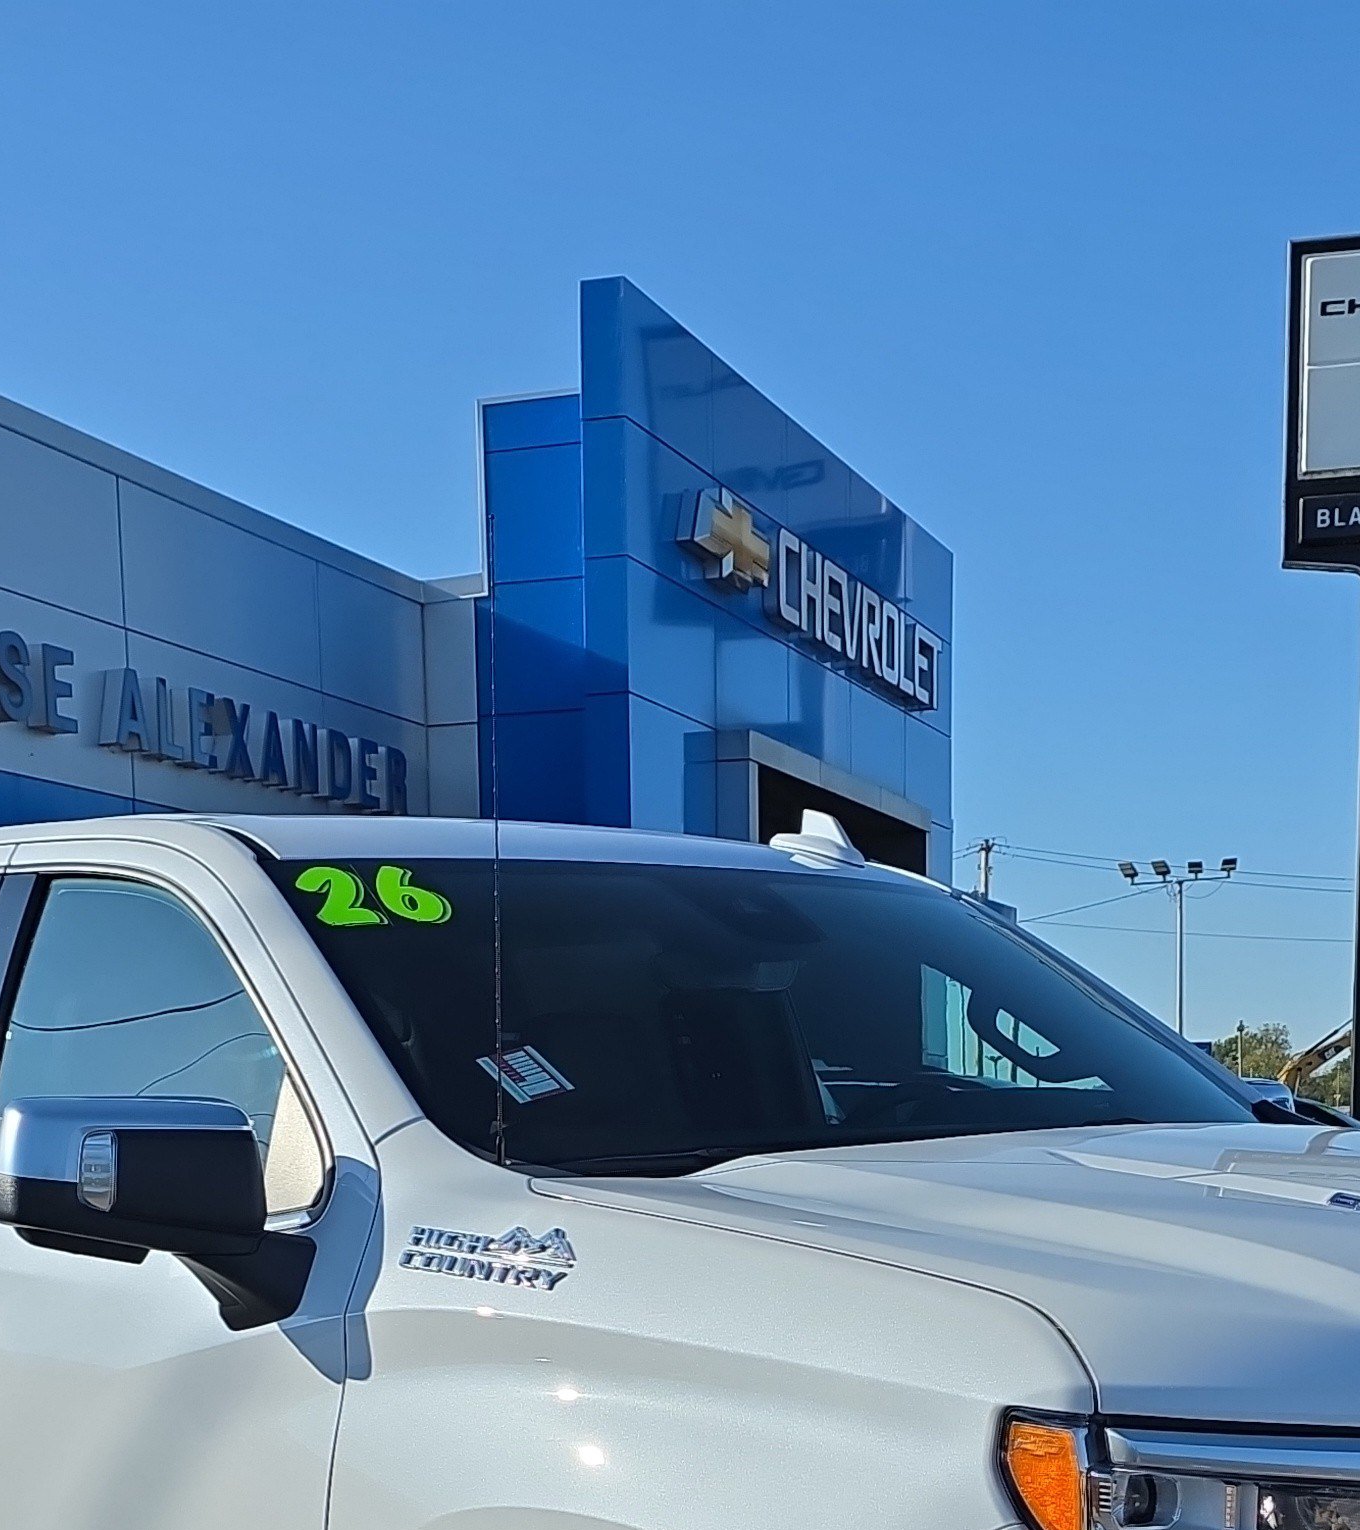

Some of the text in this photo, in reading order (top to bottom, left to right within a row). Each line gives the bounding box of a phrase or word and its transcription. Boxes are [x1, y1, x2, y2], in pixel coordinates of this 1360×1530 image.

[779, 526, 944, 710] CHEVROLET
[98, 667, 409, 815] ALEXANDER
[294, 865, 452, 926] 26
[398, 1249, 569, 1291] COUNTRY
[408, 1226, 496, 1253] HIGH
